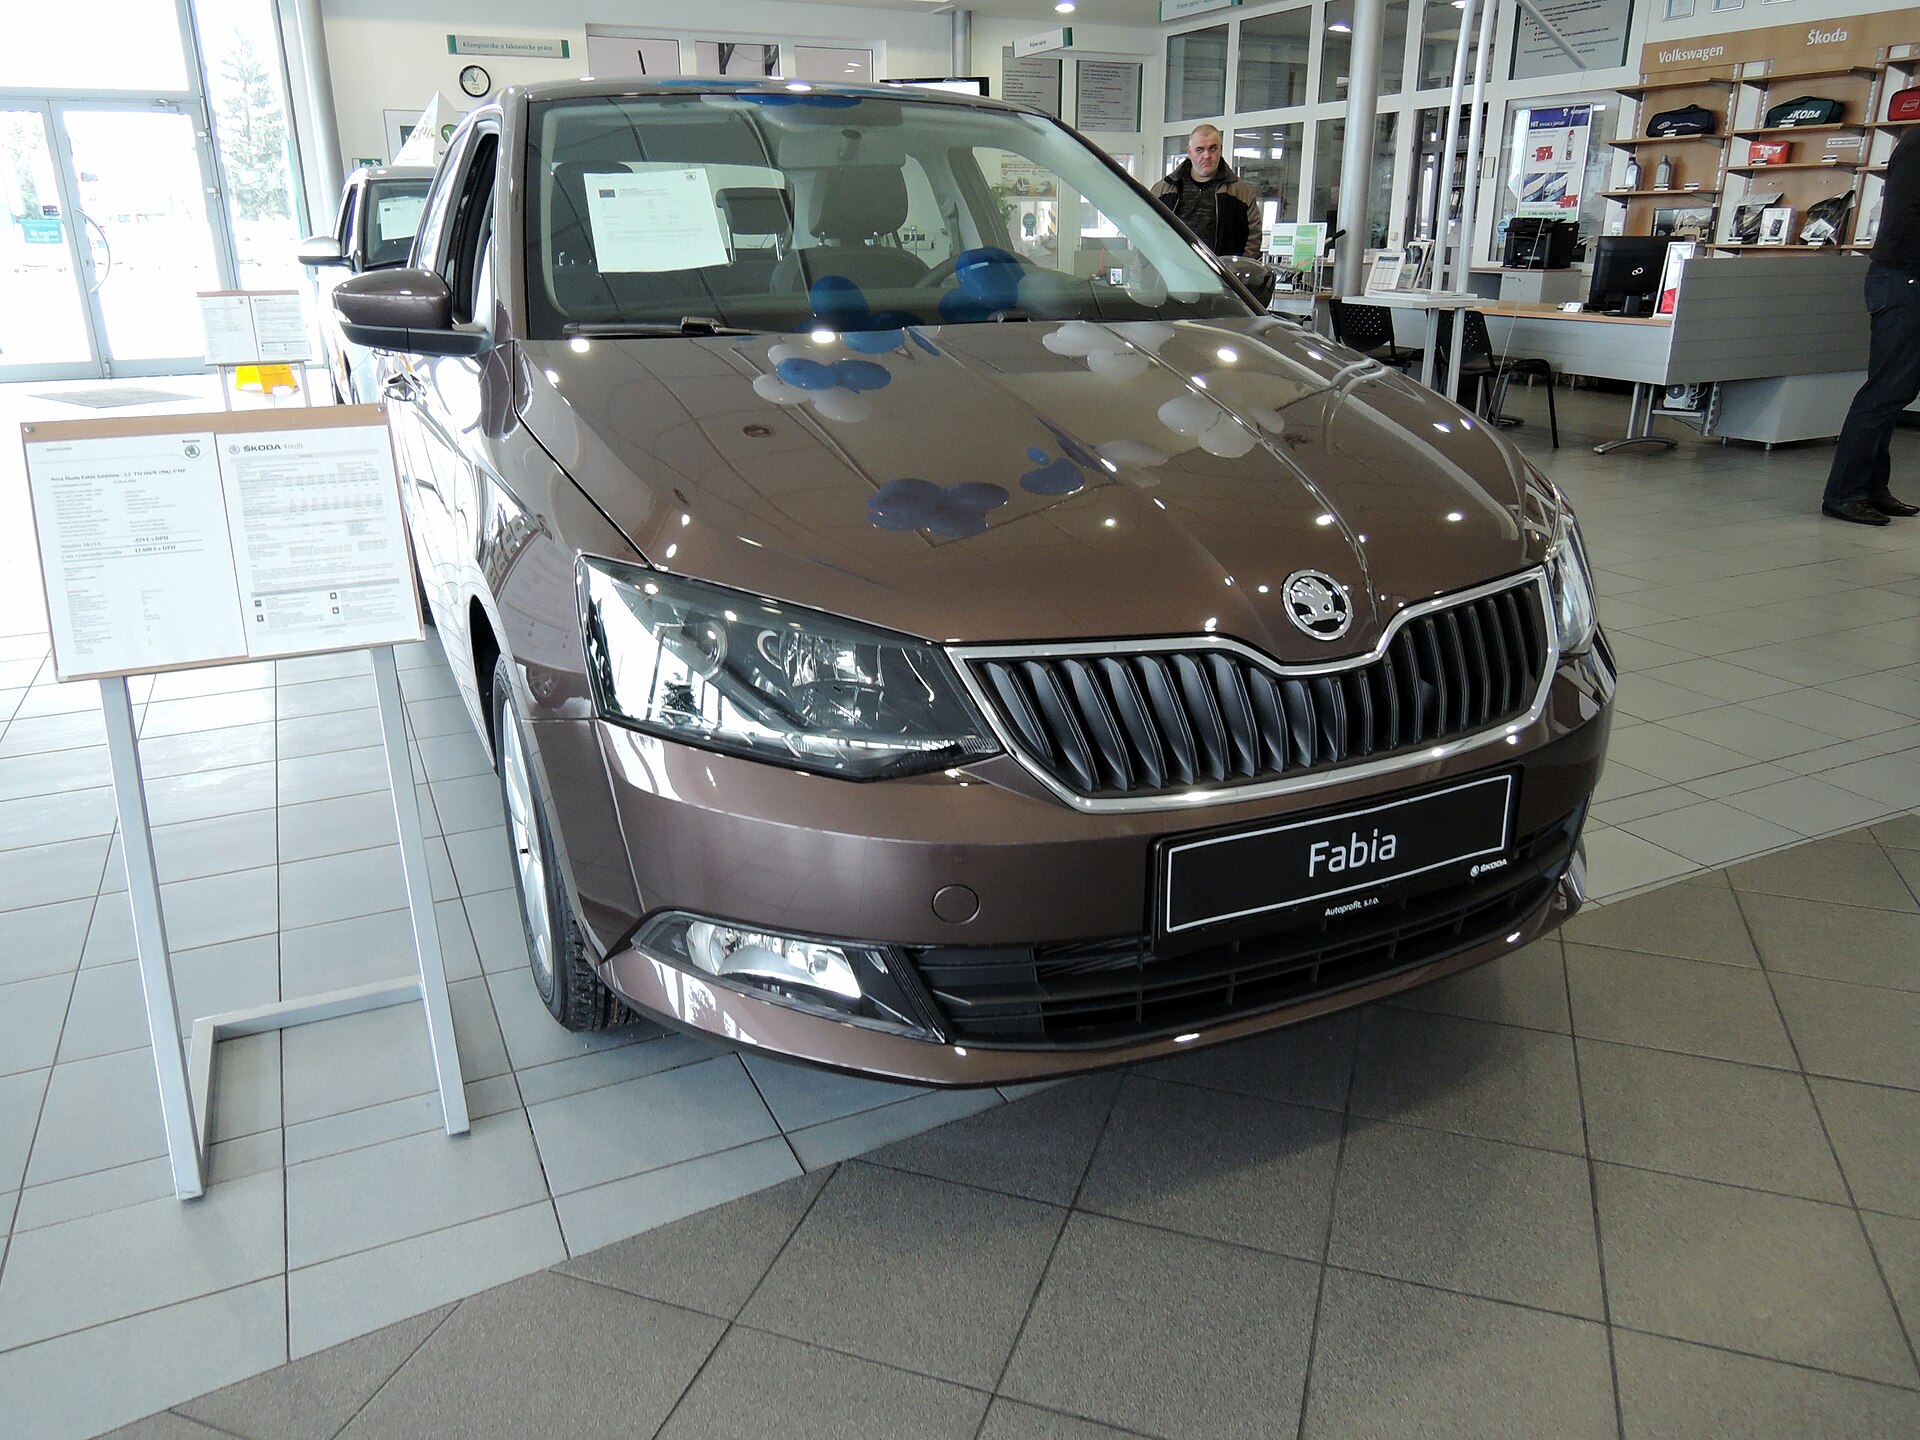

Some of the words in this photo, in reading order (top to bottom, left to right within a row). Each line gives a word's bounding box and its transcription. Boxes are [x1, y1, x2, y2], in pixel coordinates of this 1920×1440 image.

[1807, 27, 1848, 46] Škoda
[1659, 45, 1724, 64] Volkswagen
[243, 444, 282, 452] ŠKODA
[1308, 828, 1397, 878] Fabia
[1479, 858, 1508, 873] ŠKODA
